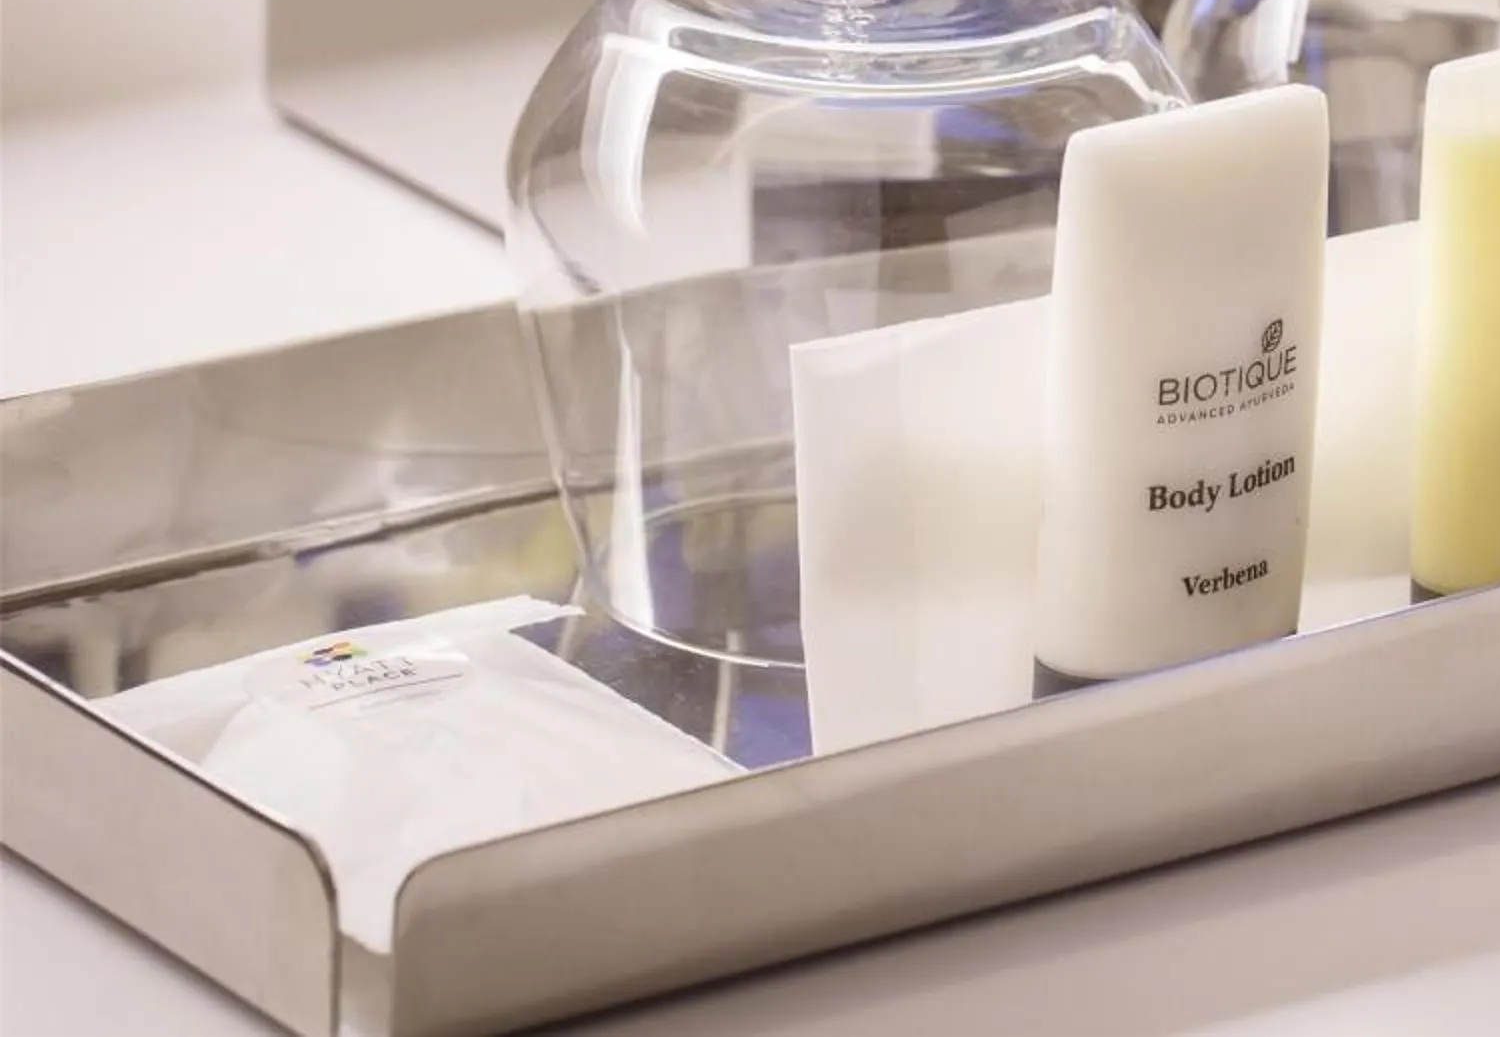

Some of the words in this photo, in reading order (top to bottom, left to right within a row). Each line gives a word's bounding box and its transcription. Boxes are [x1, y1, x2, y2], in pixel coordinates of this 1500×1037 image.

[1158, 345, 1298, 407] BIOTIQUE
[1156, 404, 1236, 426] ADVANCED
[1149, 480, 1222, 513] Body
[1229, 455, 1296, 499] Lotion
[1182, 559, 1270, 597] Verbena
